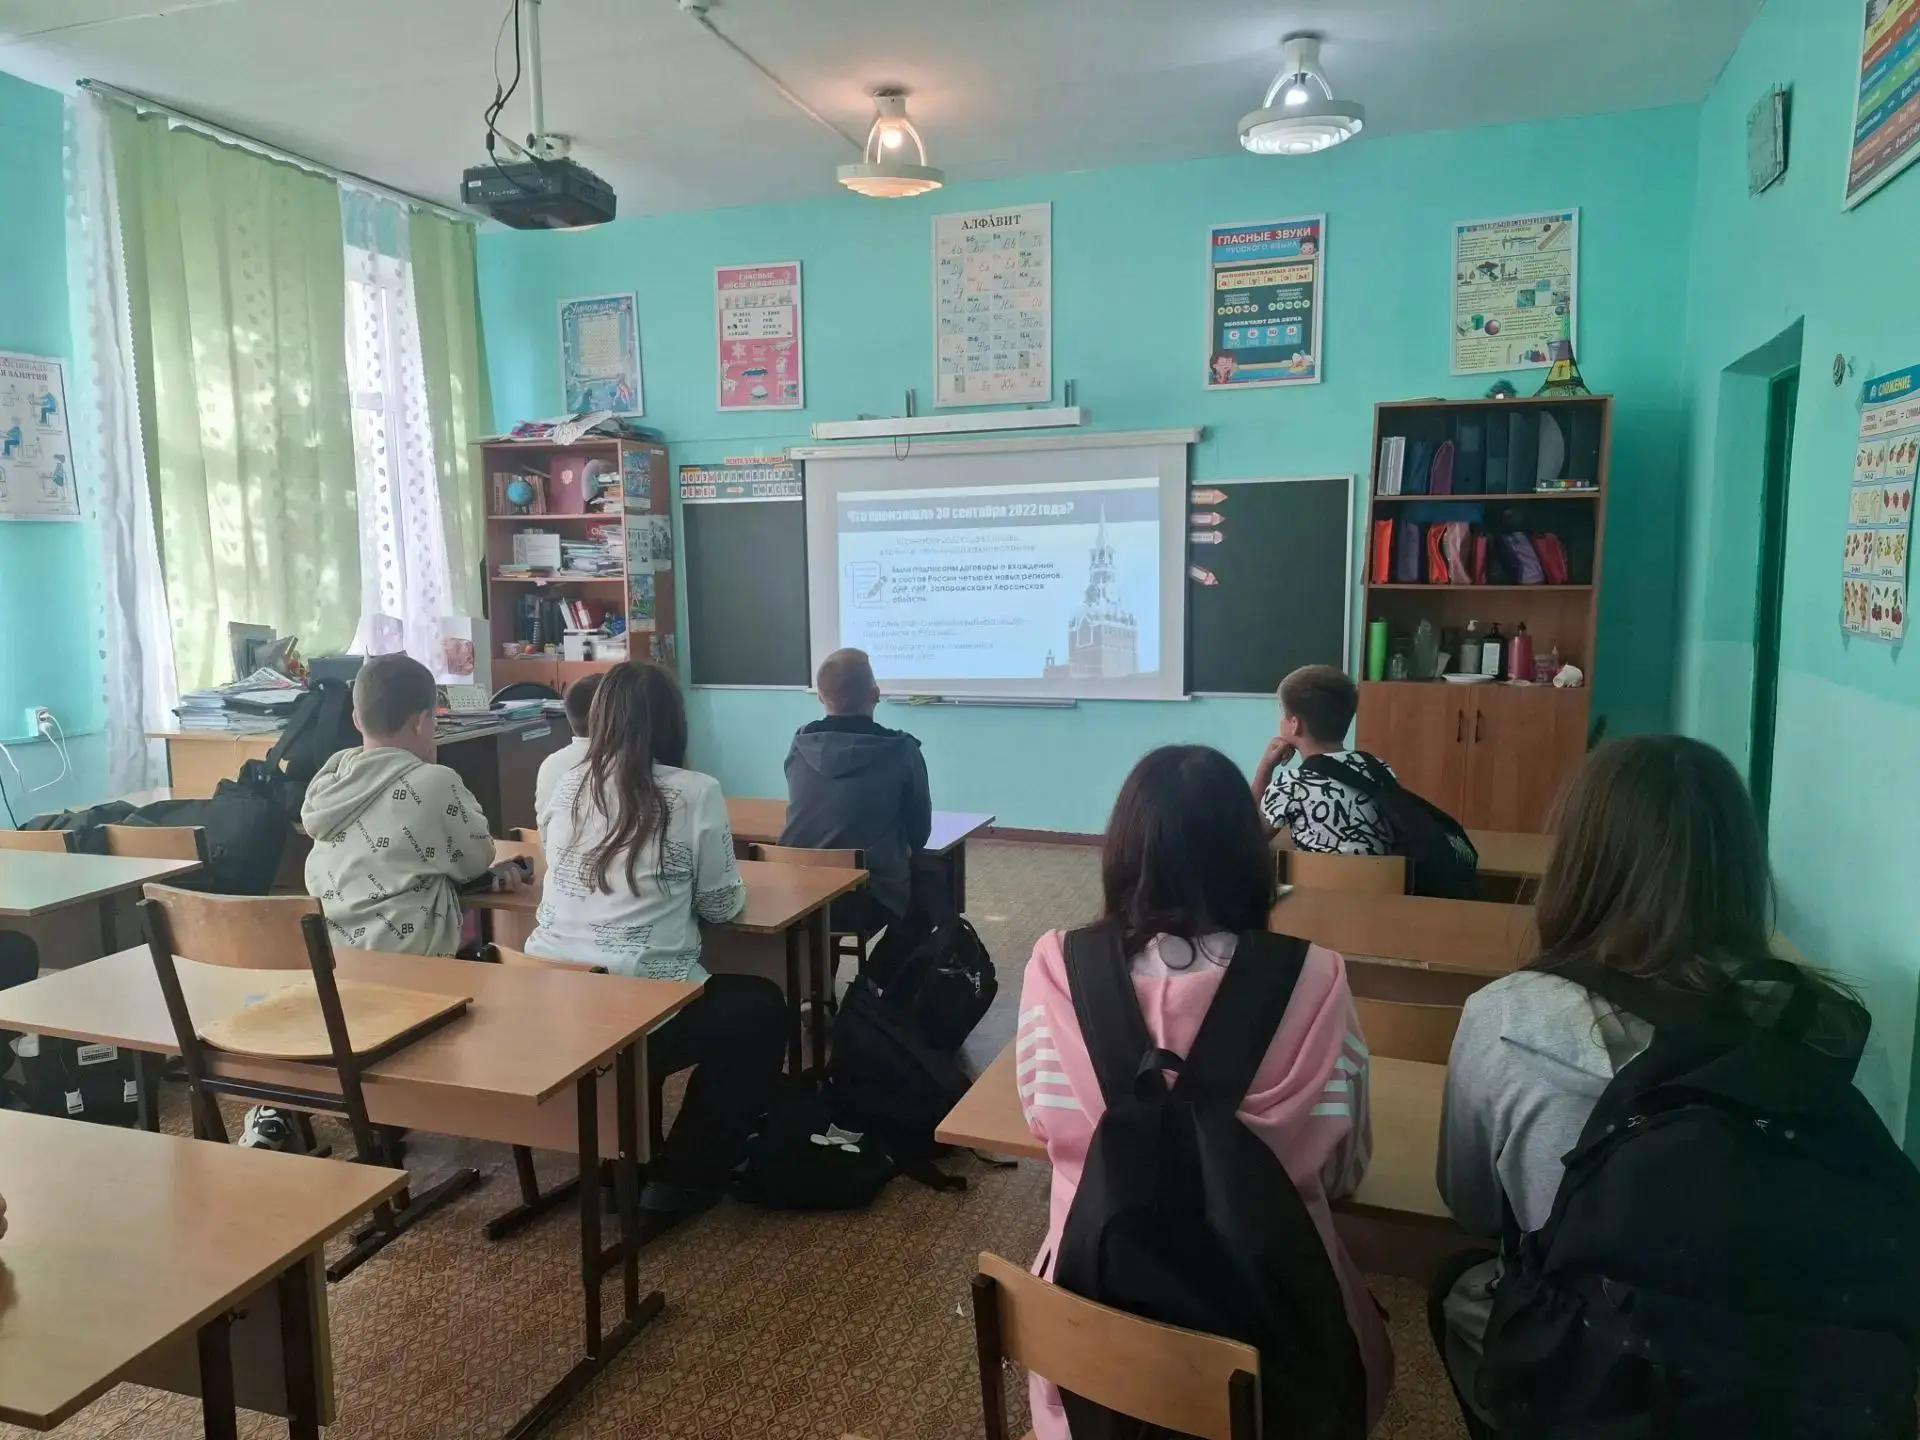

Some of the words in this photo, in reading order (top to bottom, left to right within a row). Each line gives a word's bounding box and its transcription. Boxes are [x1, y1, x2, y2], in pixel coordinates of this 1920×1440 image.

[1217, 231, 1273, 246] ГЛАСНЫЕ
[1275, 227, 1312, 240] ЗВУКИ
[868, 508, 935, 523] произошло
[936, 506, 951, 520] 30
[952, 504, 1007, 520] сентября
[1008, 502, 1038, 517] 2022
[1038, 501, 1075, 519] года?
[927, 575, 958, 583] России
[930, 584, 986, 593] Запорожская
[993, 583, 1045, 592] Херсонская
[399, 775, 422, 806] LENCIAGA
